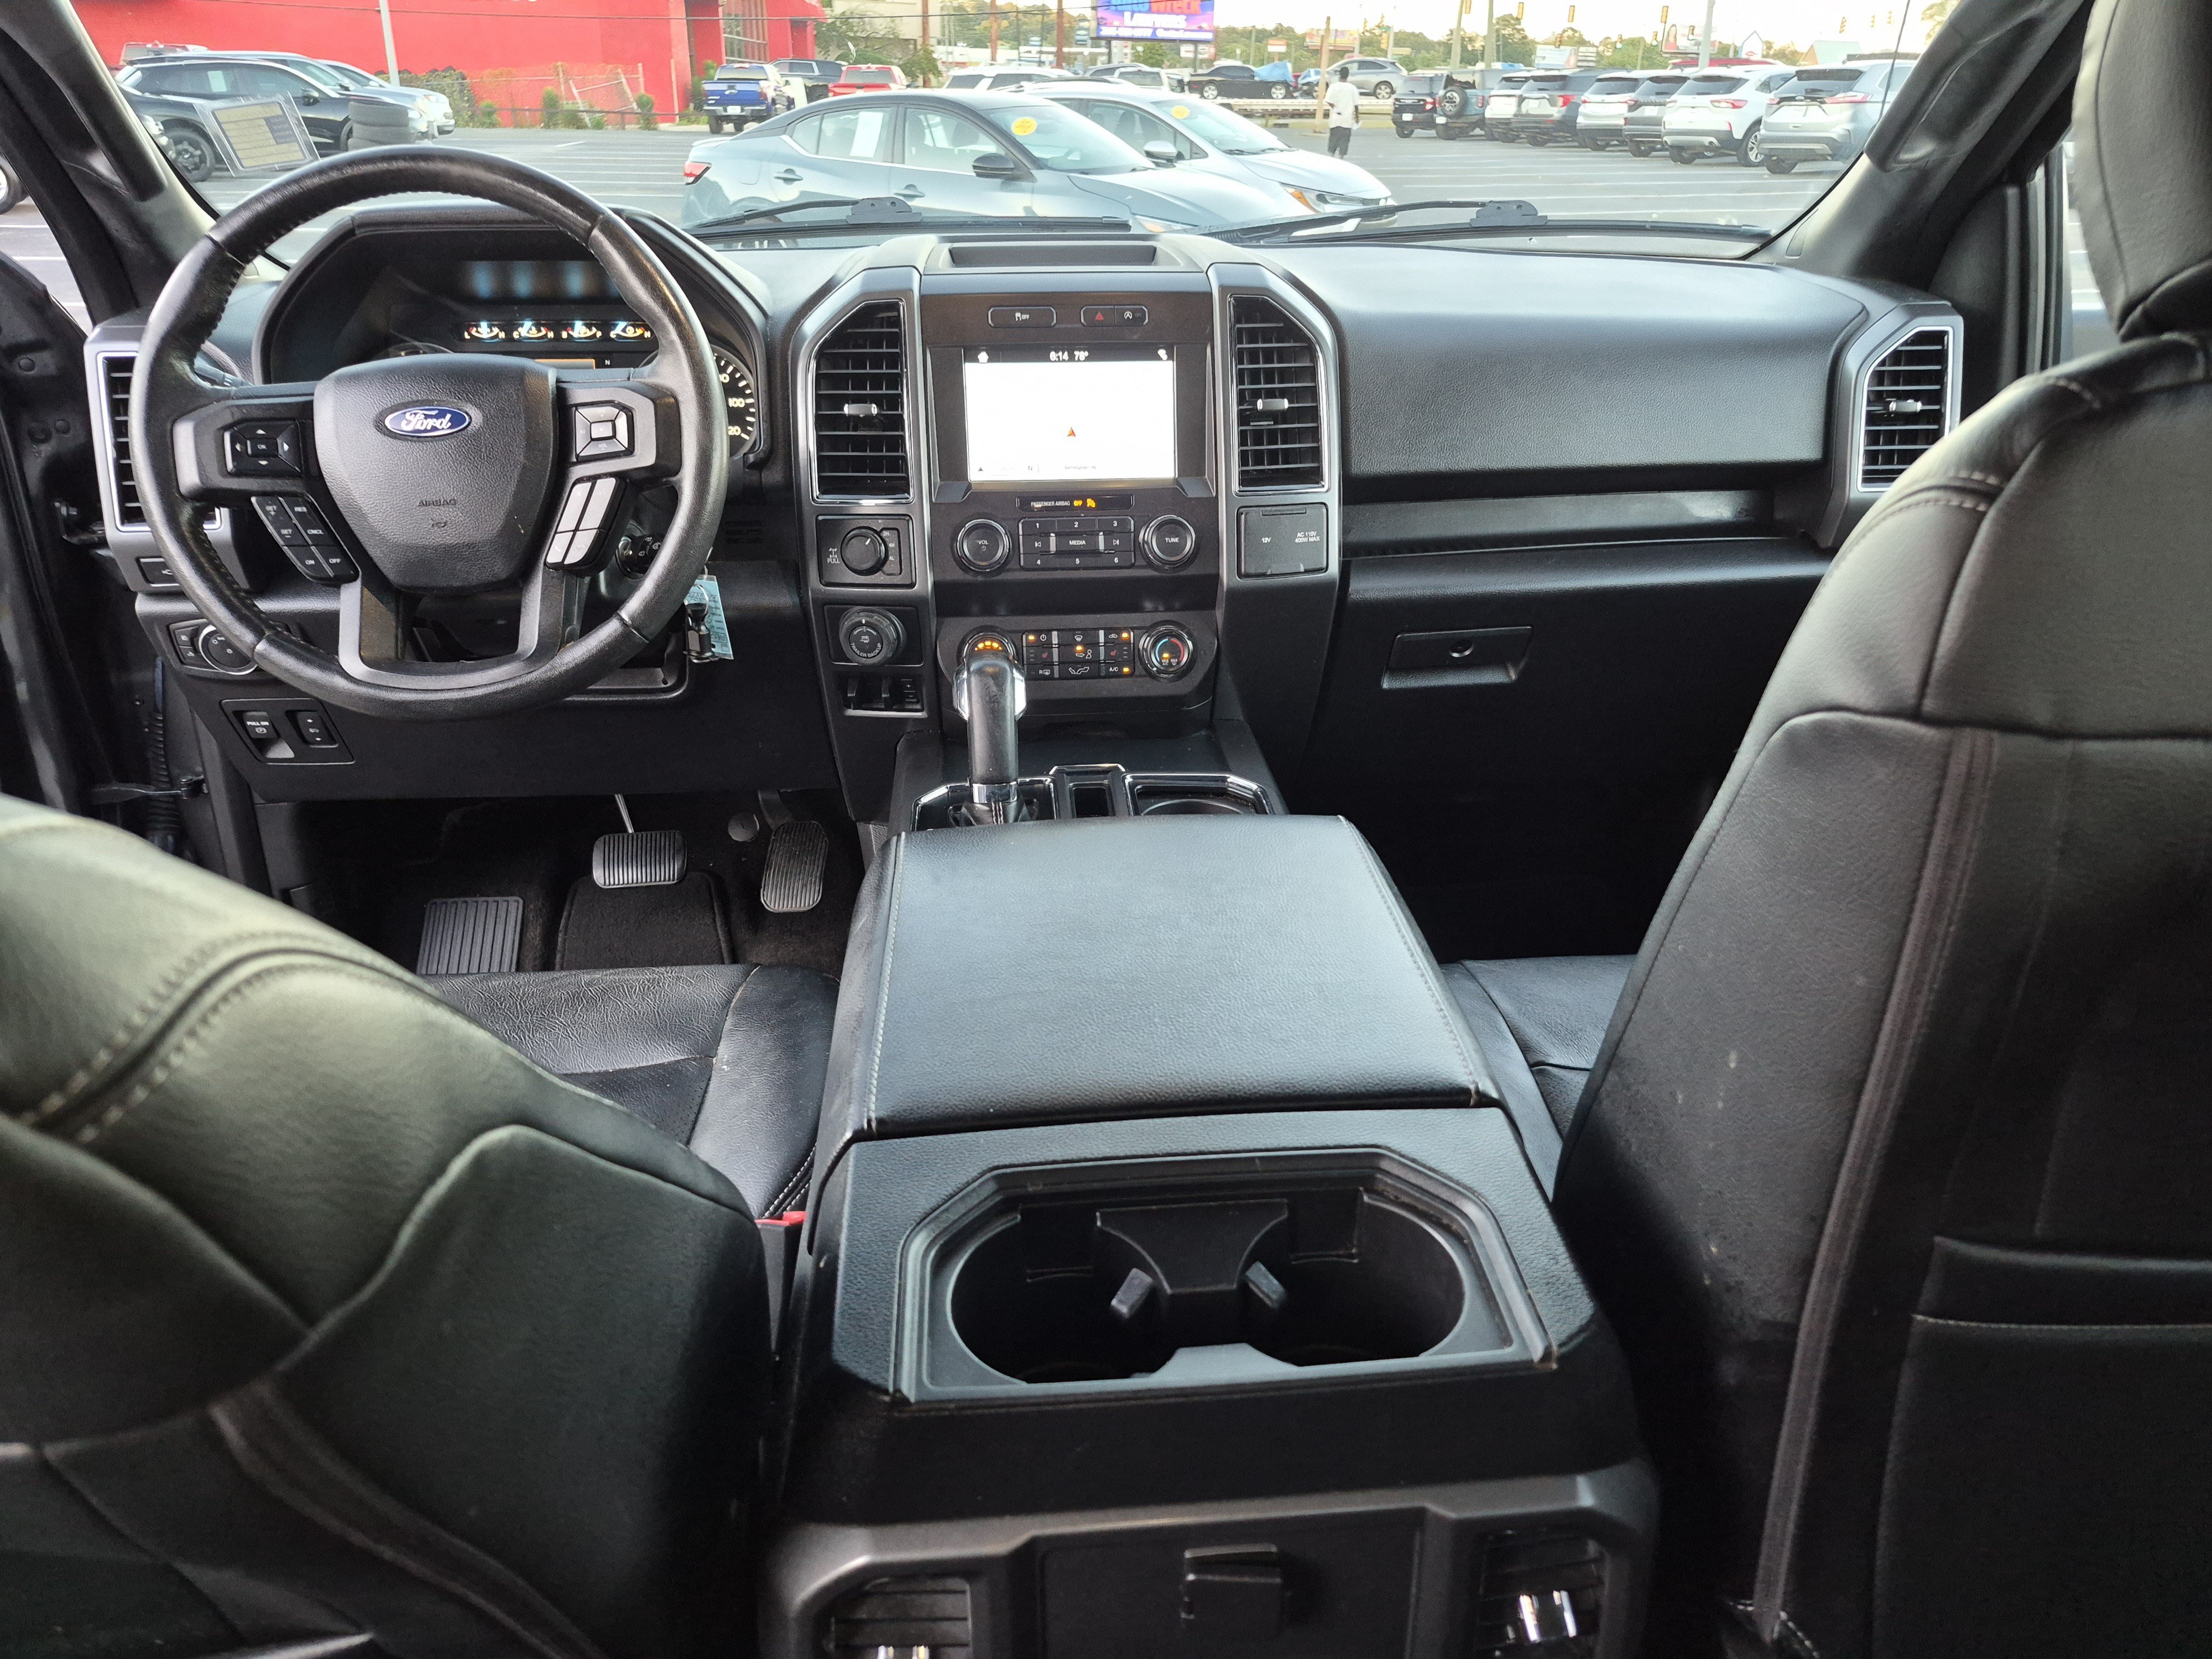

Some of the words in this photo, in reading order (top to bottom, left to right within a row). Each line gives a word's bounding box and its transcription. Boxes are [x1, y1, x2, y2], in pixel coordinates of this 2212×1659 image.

[1050, 351, 1069, 361] 6:14
[728, 398, 745, 408] 100
[401, 410, 452, 431] Ford
[851, 642, 867, 658] TRAILER
[867, 643, 882, 658] BACKUP
